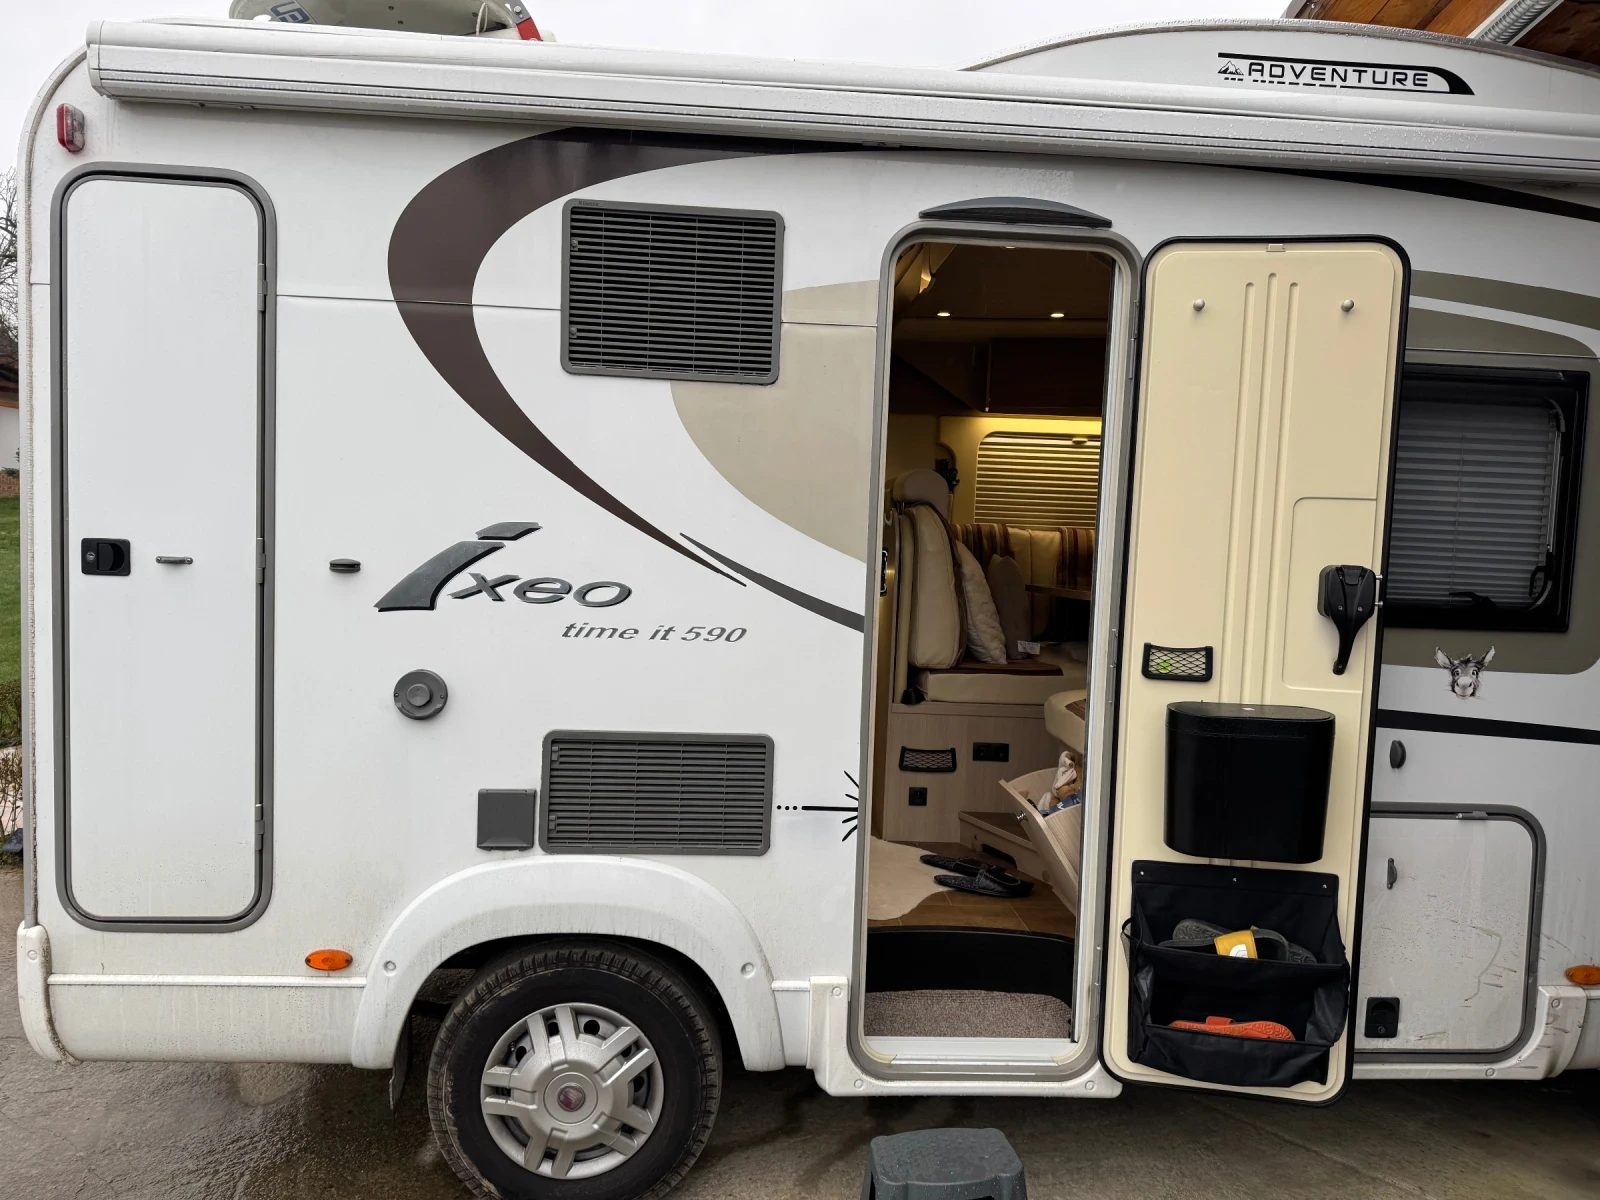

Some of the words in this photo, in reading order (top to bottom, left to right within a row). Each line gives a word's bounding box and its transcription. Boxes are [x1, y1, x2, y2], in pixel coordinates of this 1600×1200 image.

[1247, 61, 1429, 87] ADVENTURE
[561, 622, 640, 640] time
[648, 624, 677, 641] it
[680, 626, 748, 643] 590
